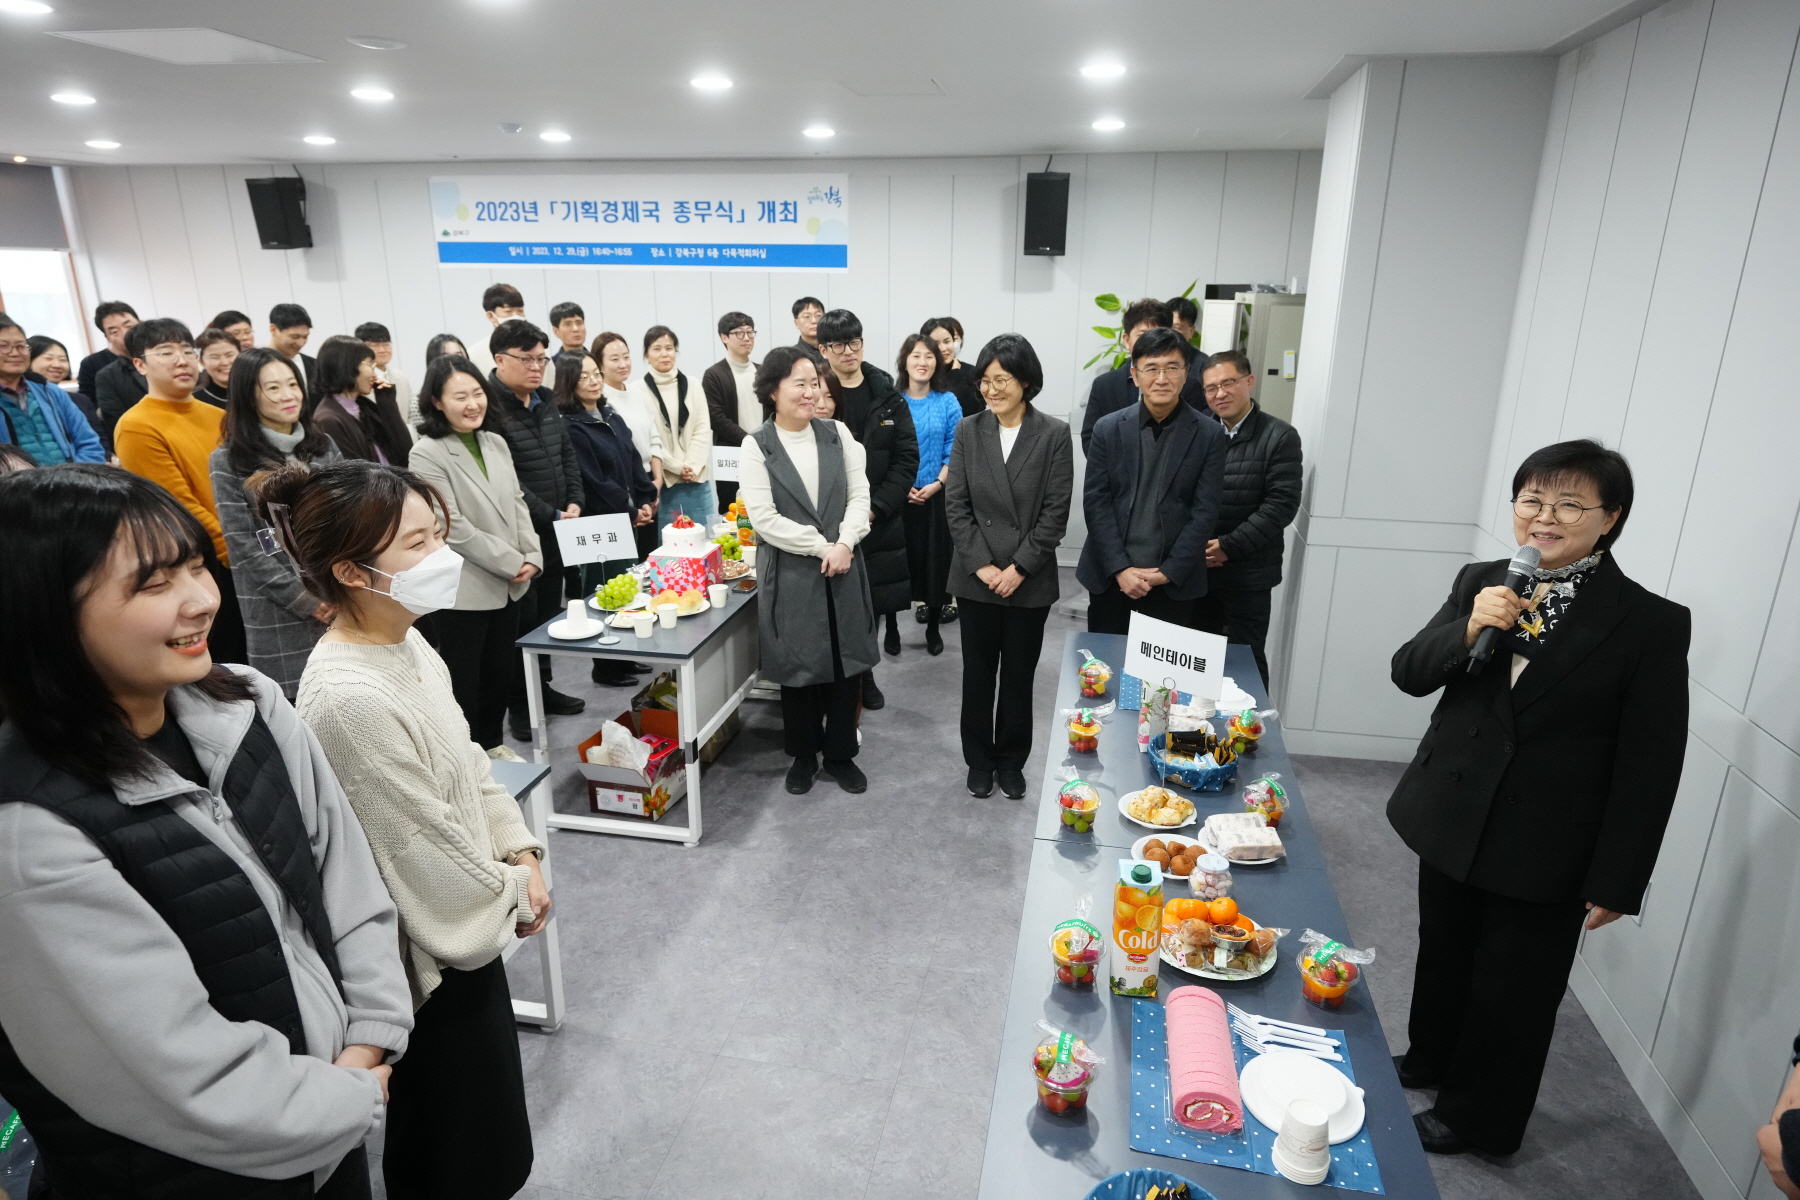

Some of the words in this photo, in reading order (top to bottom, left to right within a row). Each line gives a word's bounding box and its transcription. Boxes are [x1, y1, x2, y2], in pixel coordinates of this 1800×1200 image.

[475, 201, 539, 223] 2023년
[550, 200, 660, 224] 「기획경제국
[673, 201, 745, 224] 종무식」
[757, 201, 798, 224] 개최
[508, 246, 524, 256] 일시
[650, 247, 666, 258] 장소
[675, 248, 704, 258] 강북구청
[707, 248, 719, 258] 6층
[722, 248, 767, 259] 다목적회의실
[1140, 641, 1206, 673] 메인테이블
[1118, 929, 1159, 949] Cold
